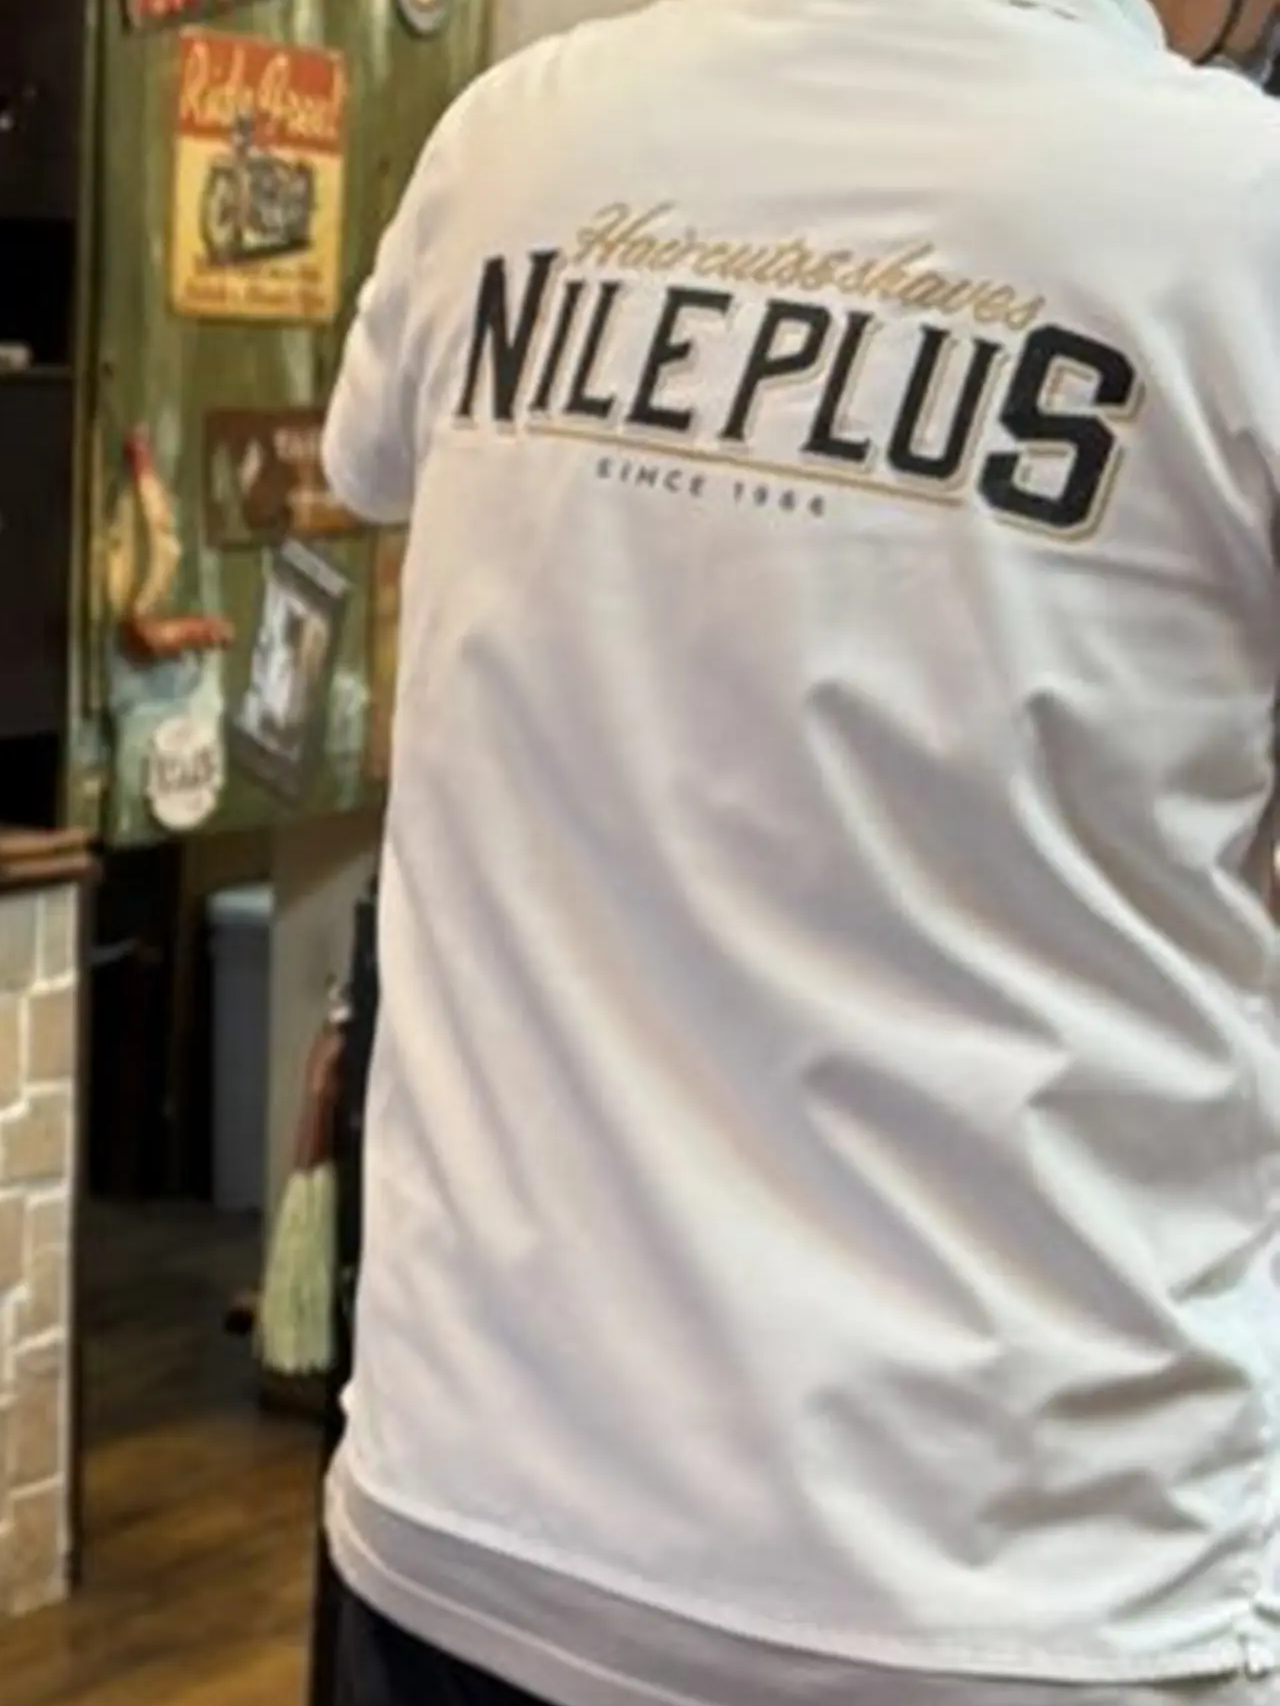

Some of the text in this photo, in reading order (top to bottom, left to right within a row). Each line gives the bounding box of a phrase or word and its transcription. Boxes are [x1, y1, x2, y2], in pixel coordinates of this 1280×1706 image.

[452, 249, 1142, 535] NILE PLUS
[596, 456, 706, 498] SINCE
